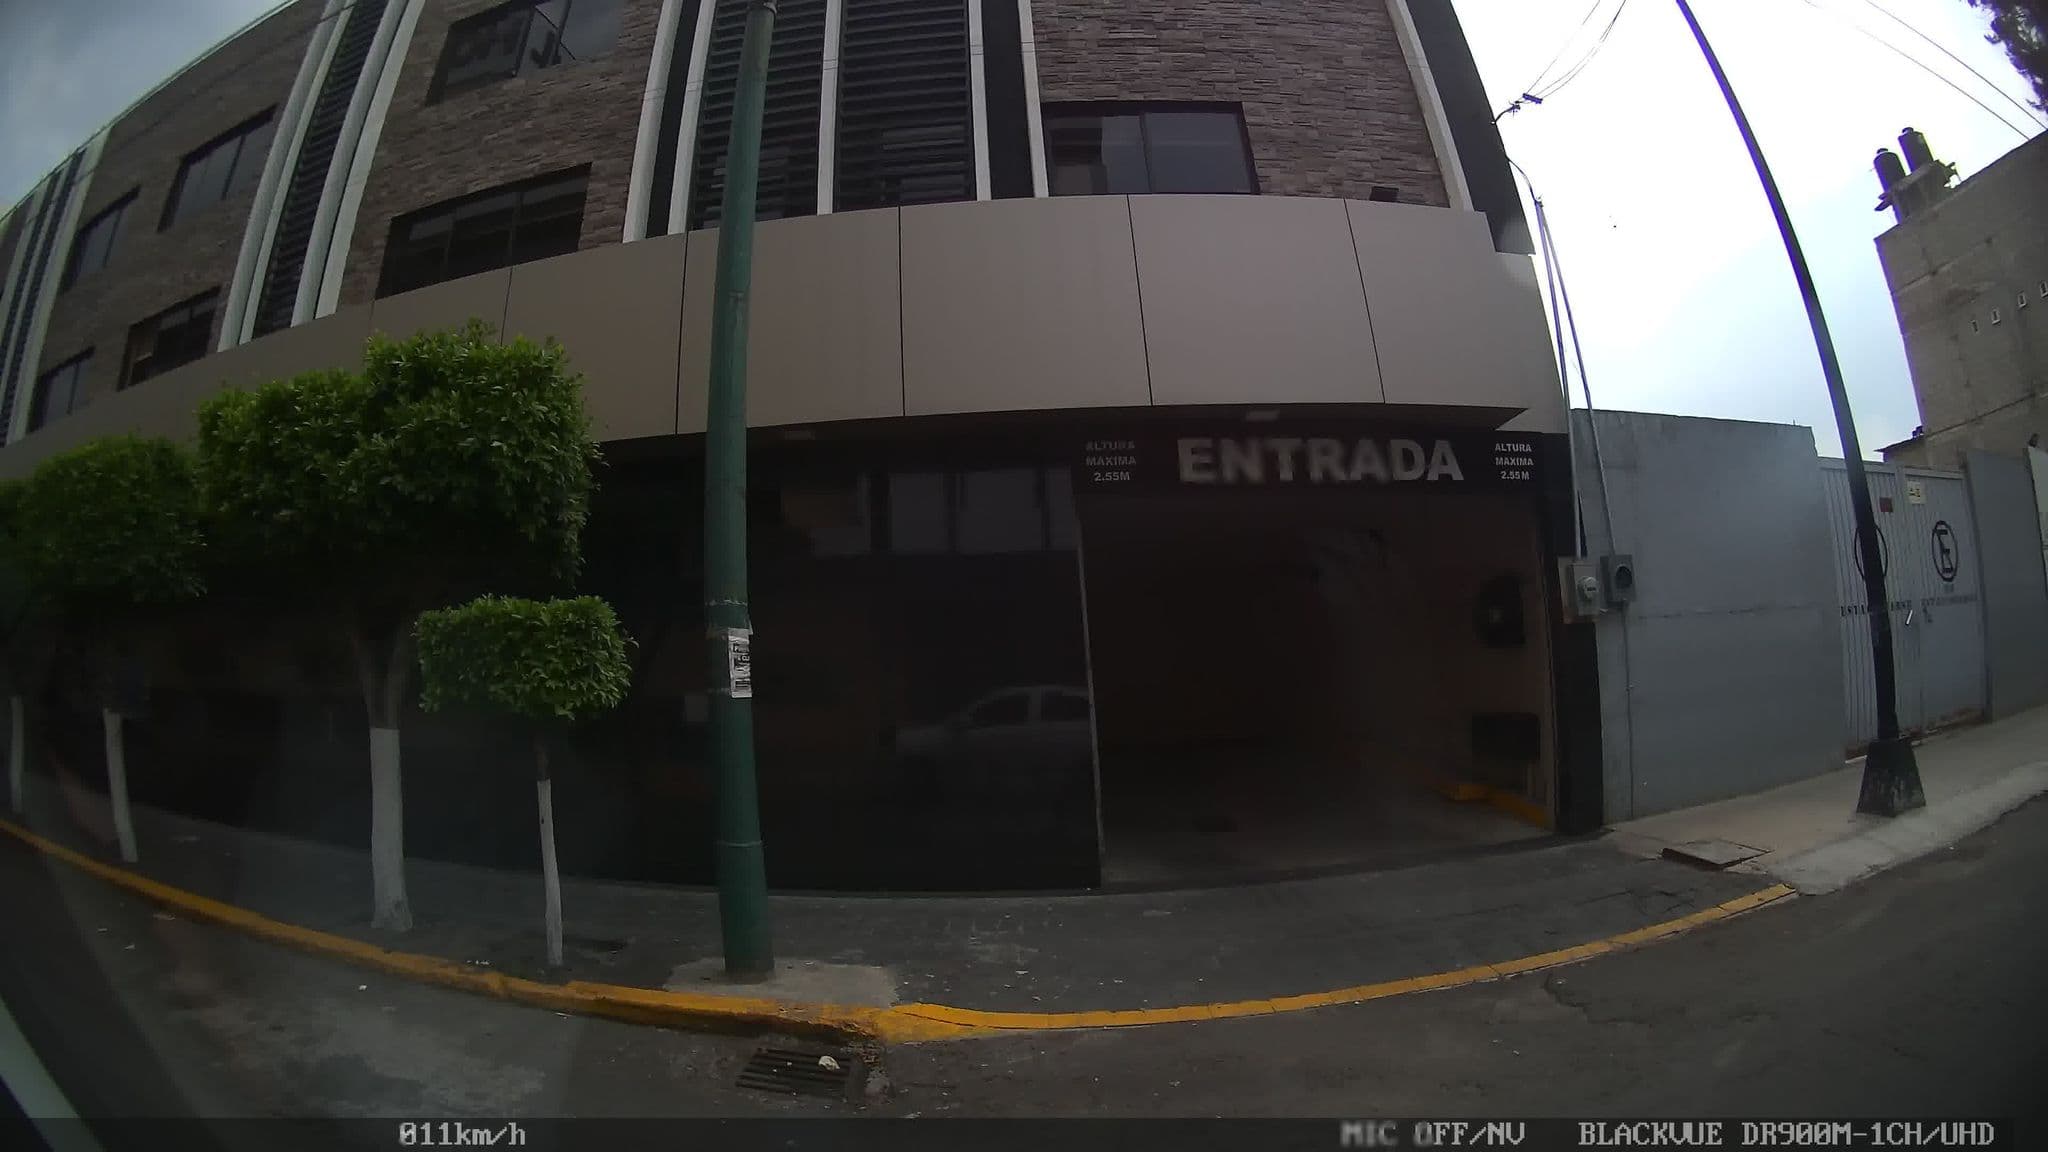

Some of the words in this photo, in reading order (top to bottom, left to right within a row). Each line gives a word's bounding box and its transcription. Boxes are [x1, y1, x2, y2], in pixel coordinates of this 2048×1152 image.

[1086, 440, 1136, 450] ALTURA
[1495, 443, 1533, 452] ALTURA
[1086, 455, 1137, 466] MAXIMA
[1177, 438, 1465, 482] ENTRADA
[1495, 456, 1534, 466] MAXIMA
[1093, 471, 1130, 481] 2.55M
[1500, 469, 1530, 480] 2.55M
